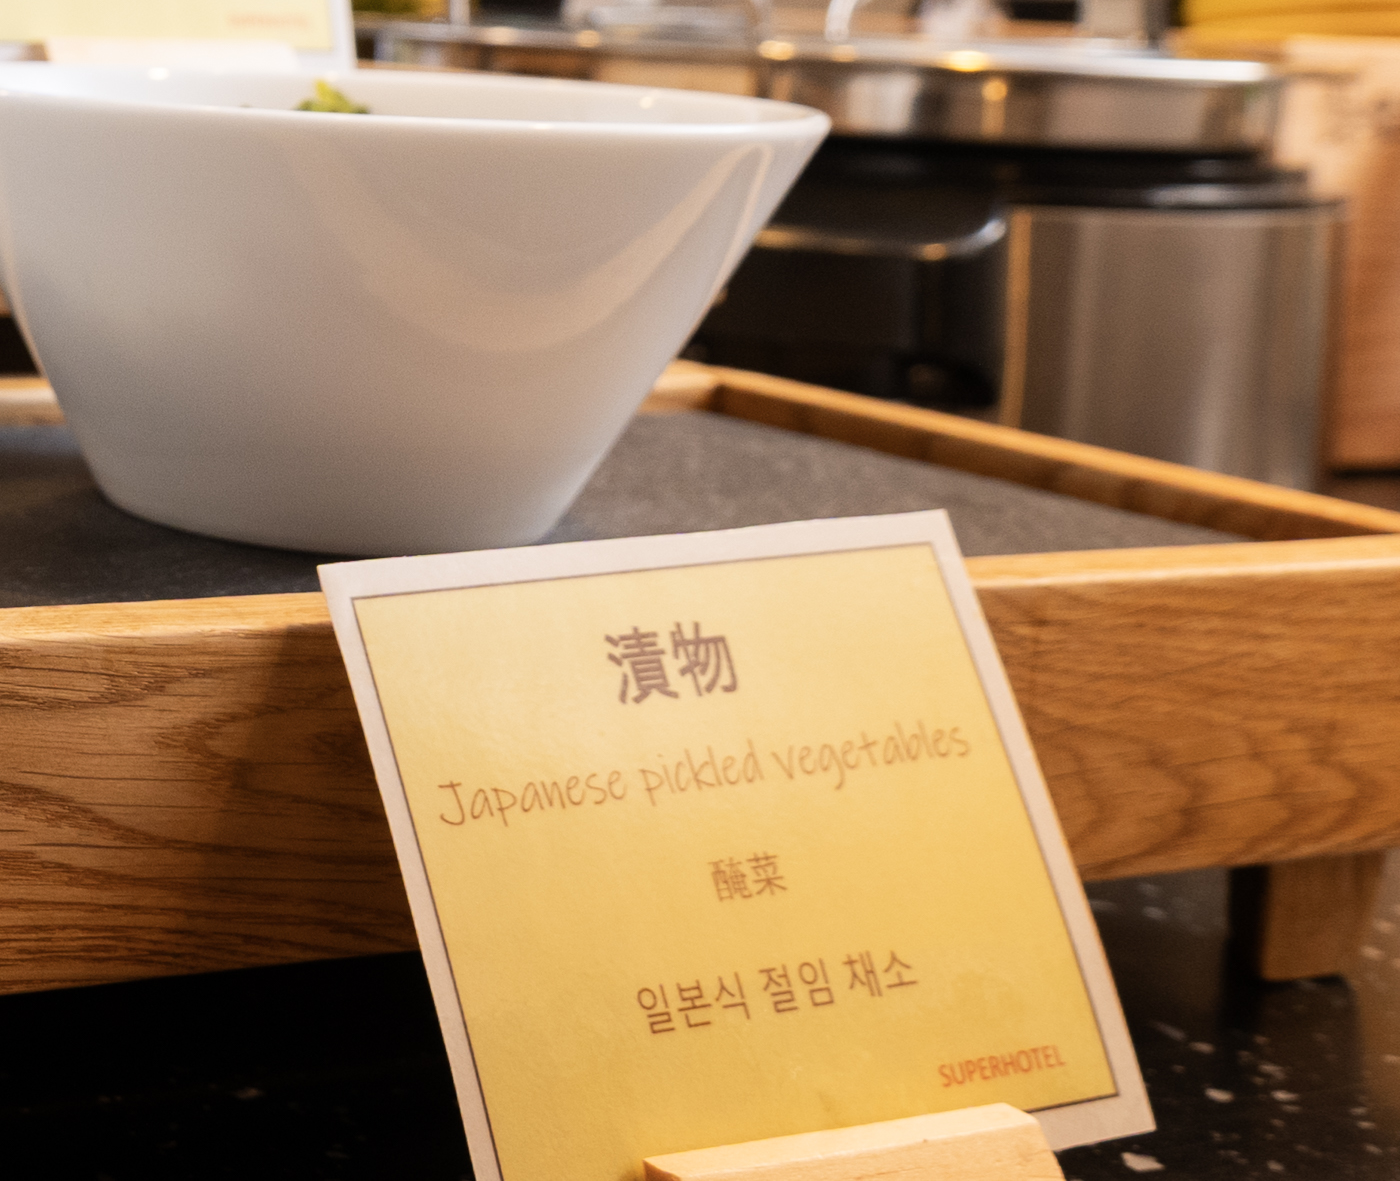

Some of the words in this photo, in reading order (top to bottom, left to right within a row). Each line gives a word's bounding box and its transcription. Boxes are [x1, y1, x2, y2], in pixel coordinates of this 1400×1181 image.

[604, 621, 738, 705] 漬物
[438, 769, 628, 828] Japanese
[638, 739, 764, 807] pickled
[771, 720, 971, 791] vegetables
[636, 971, 751, 1035] 일본식
[759, 957, 835, 1014] 절임
[842, 950, 919, 998] 채소
[938, 1044, 1066, 1088] SUPERHOTEL
